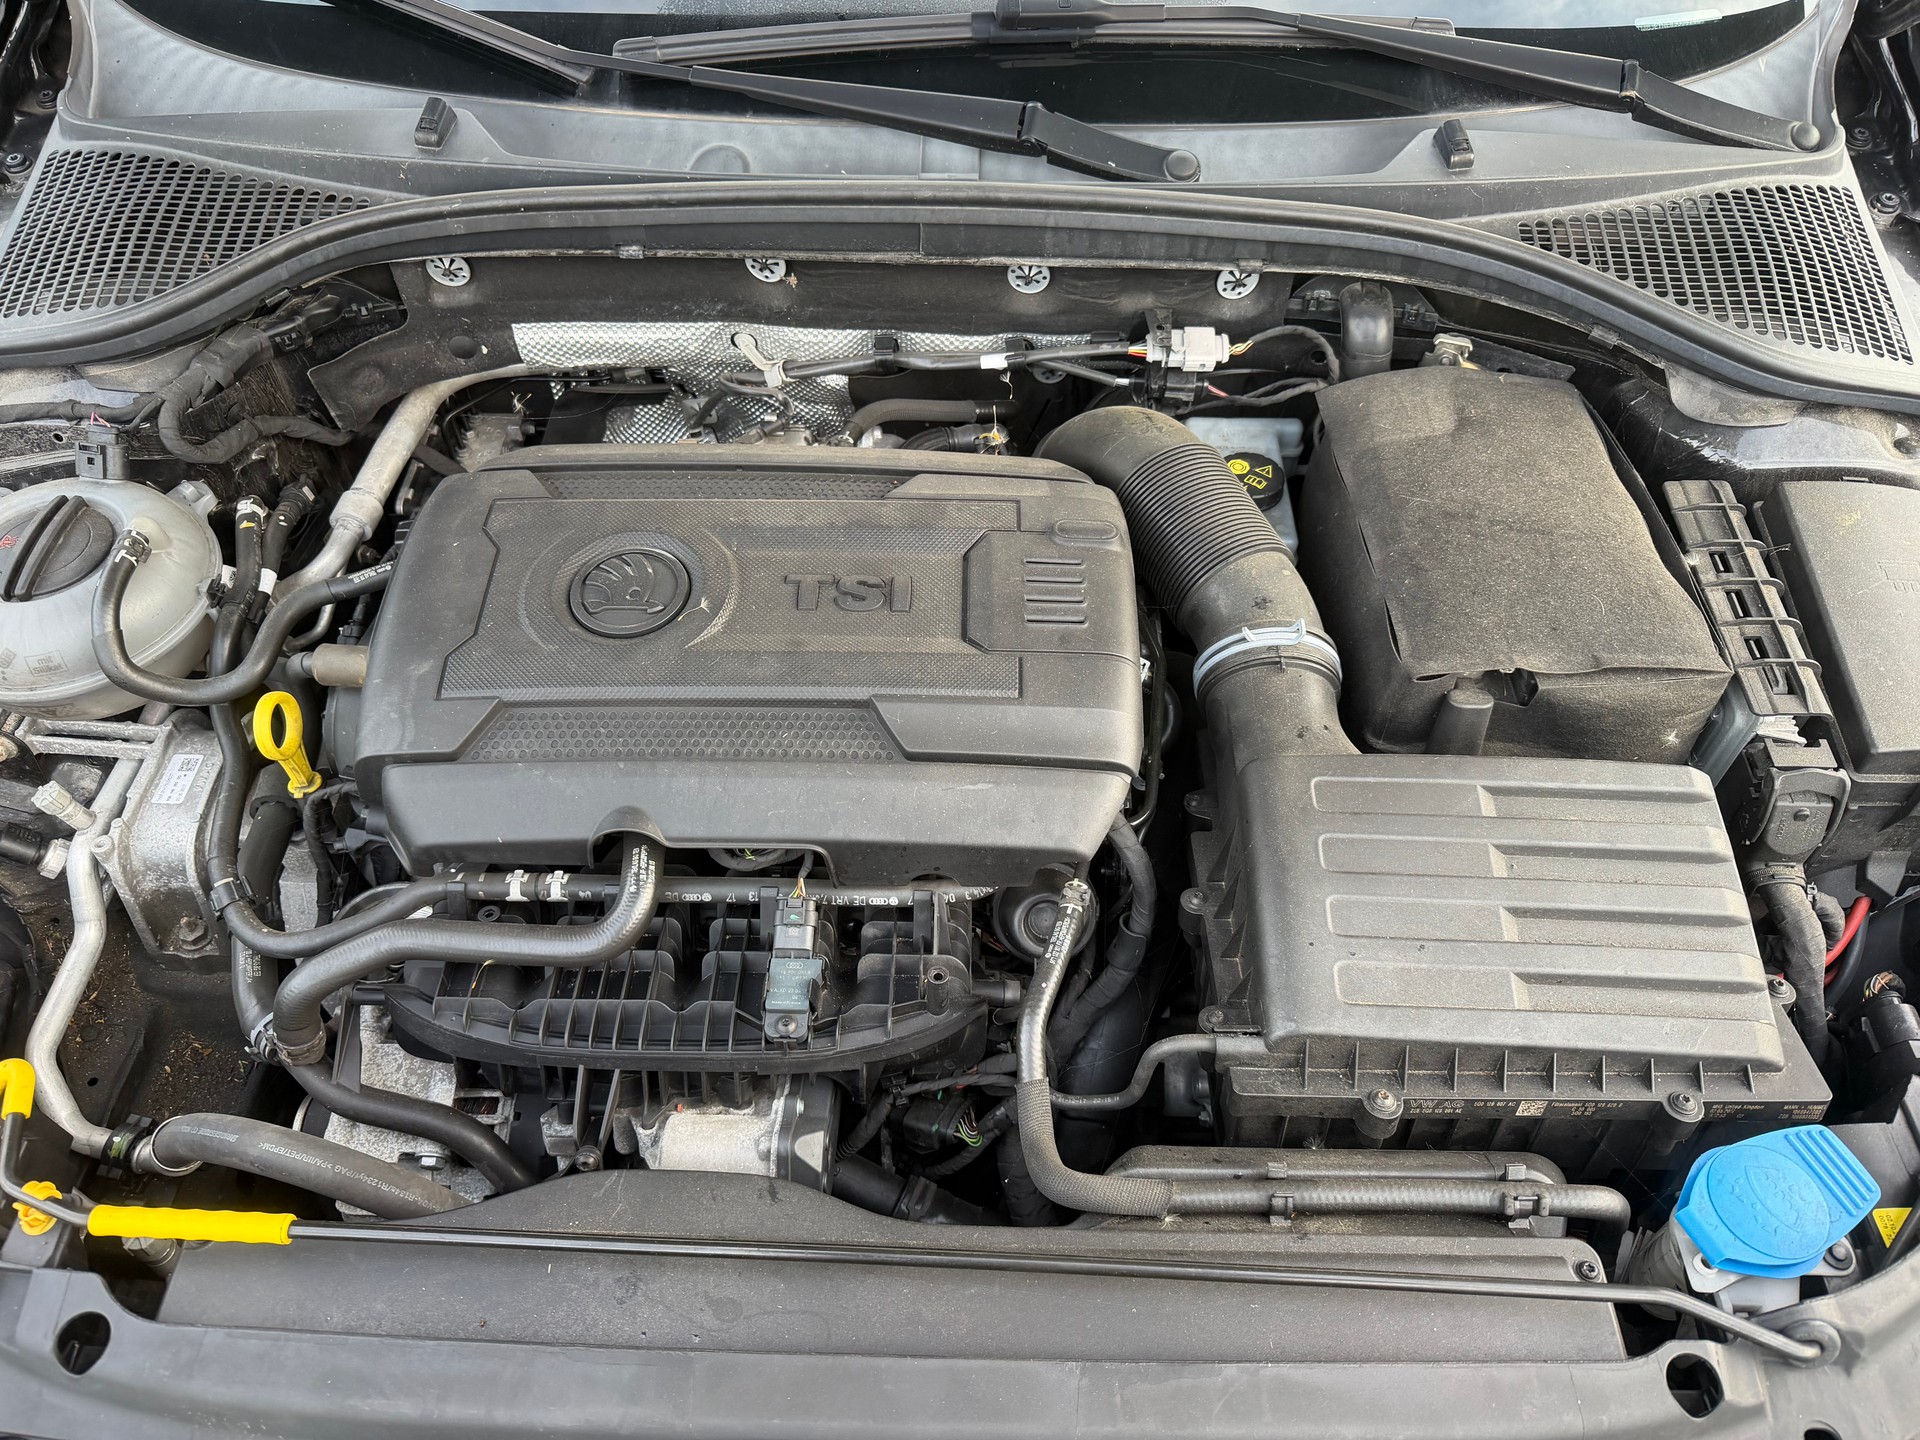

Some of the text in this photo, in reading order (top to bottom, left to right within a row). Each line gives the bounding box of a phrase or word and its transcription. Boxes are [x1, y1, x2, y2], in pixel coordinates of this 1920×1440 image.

[784, 574, 913, 613] TSI
[37, 655, 53, 666] mit
[664, 891, 759, 902] 13 17 DE
[830, 895, 850, 905] VRT
[852, 895, 866, 905] DE
[1410, 1100, 1465, 1108] VW AG
